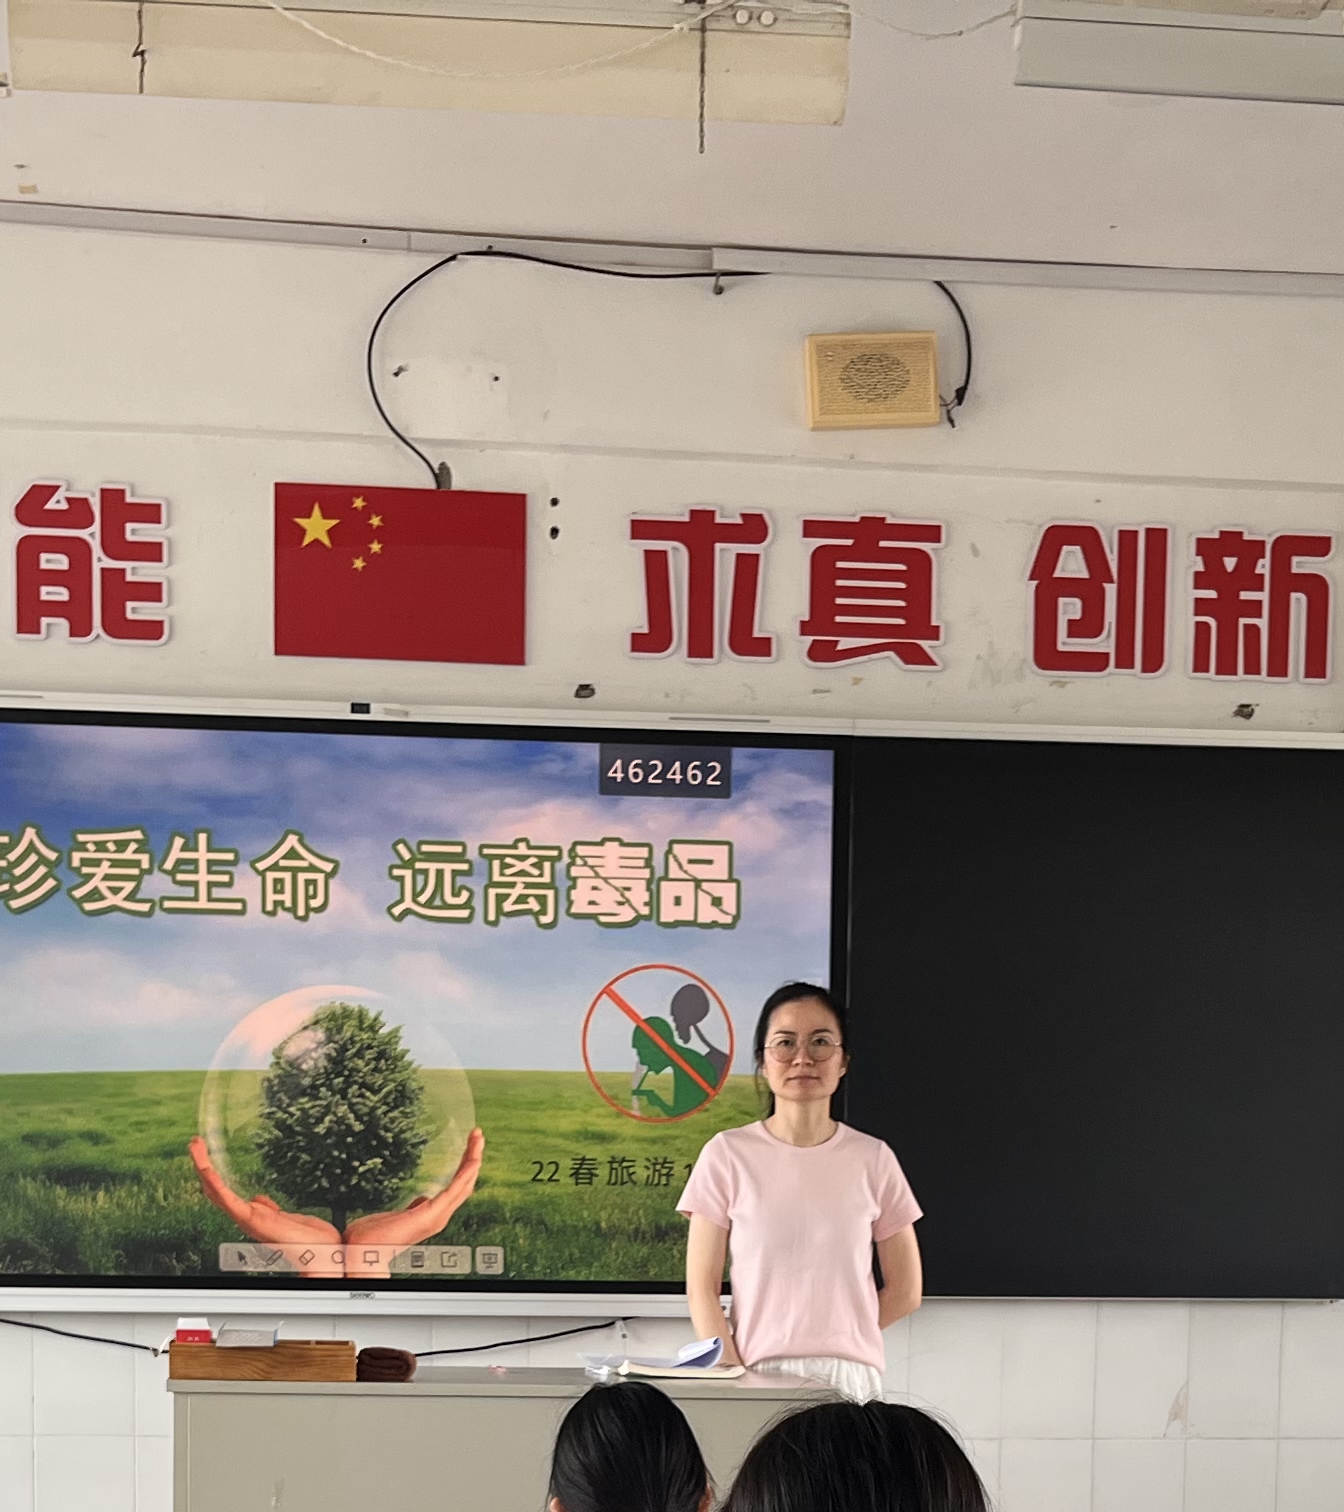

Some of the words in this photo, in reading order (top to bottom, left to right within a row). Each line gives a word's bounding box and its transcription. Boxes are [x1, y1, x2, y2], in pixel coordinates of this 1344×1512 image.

[629, 507, 945, 671] 求真
[1027, 524, 1334, 681] 创新
[606, 758, 723, 787] 462462
[388, 837, 742, 929] 远离毒品
